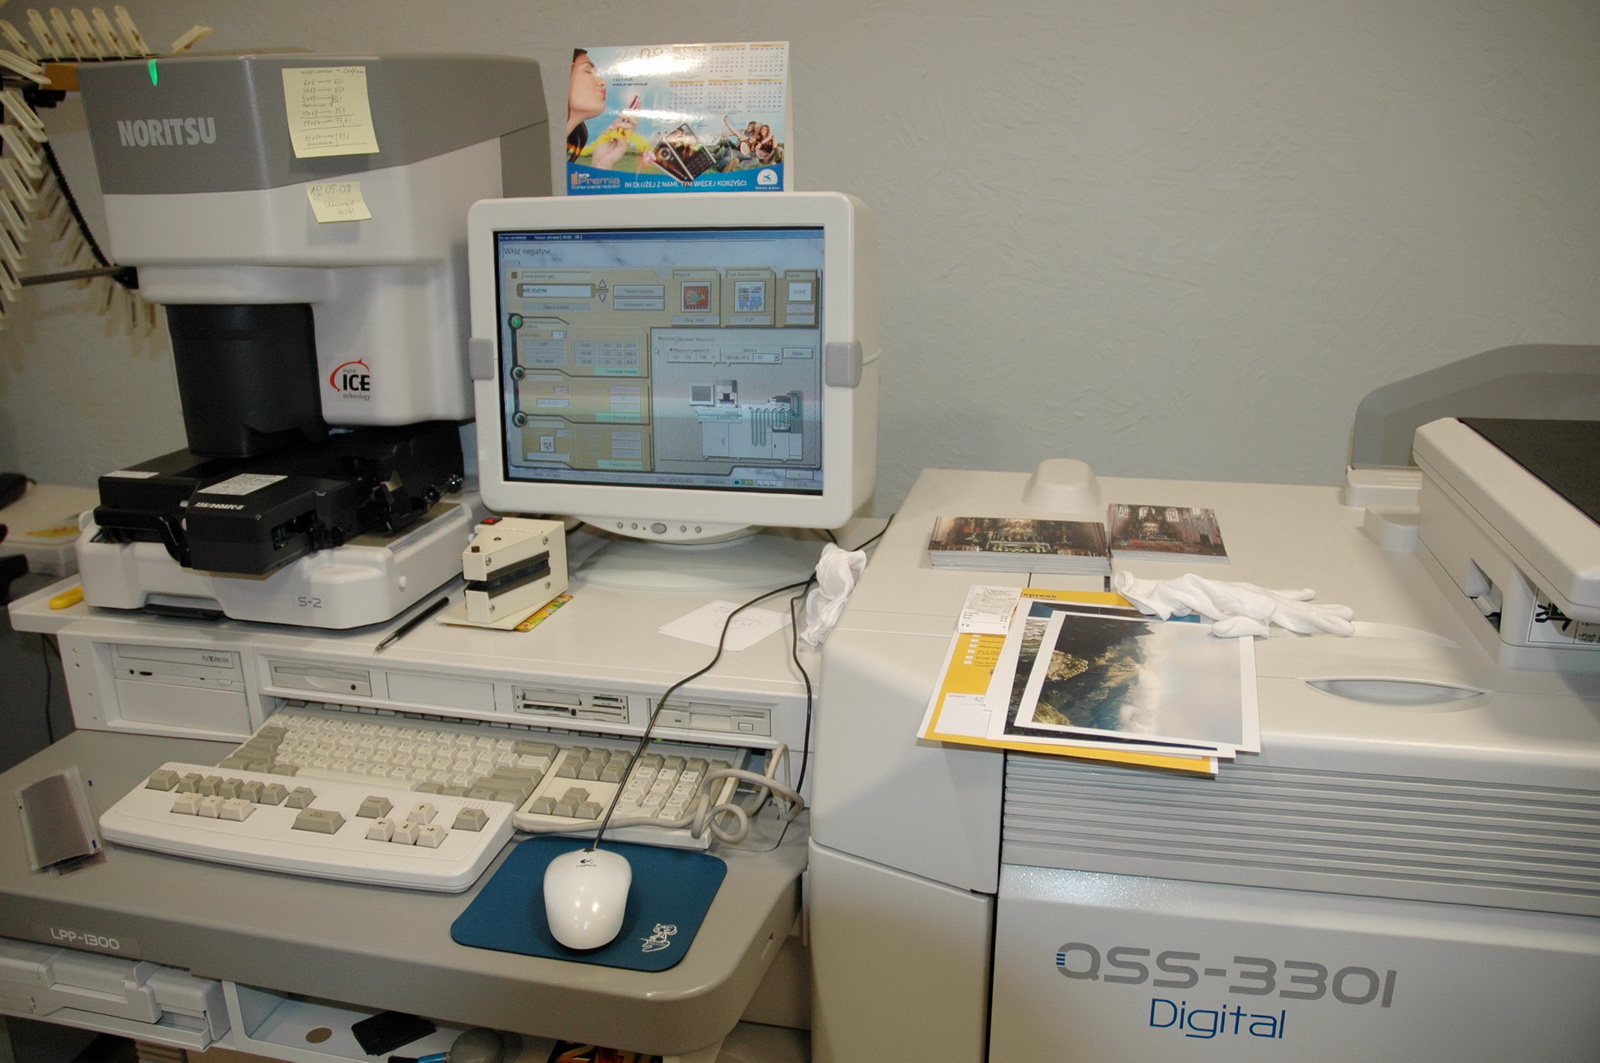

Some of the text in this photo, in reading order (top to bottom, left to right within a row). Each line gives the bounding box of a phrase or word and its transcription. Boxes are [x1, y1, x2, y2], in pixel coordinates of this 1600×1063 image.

[117, 117, 217, 147] NORITSU
[578, 177, 620, 185] Premia
[342, 373, 371, 392] ICE
[342, 393, 371, 402] technology
[297, 596, 323, 609] S-2
[50, 927, 120, 951] LPP-1300
[1055, 941, 1398, 1009] QSS-3301
[1149, 997, 1287, 1040] Digital
